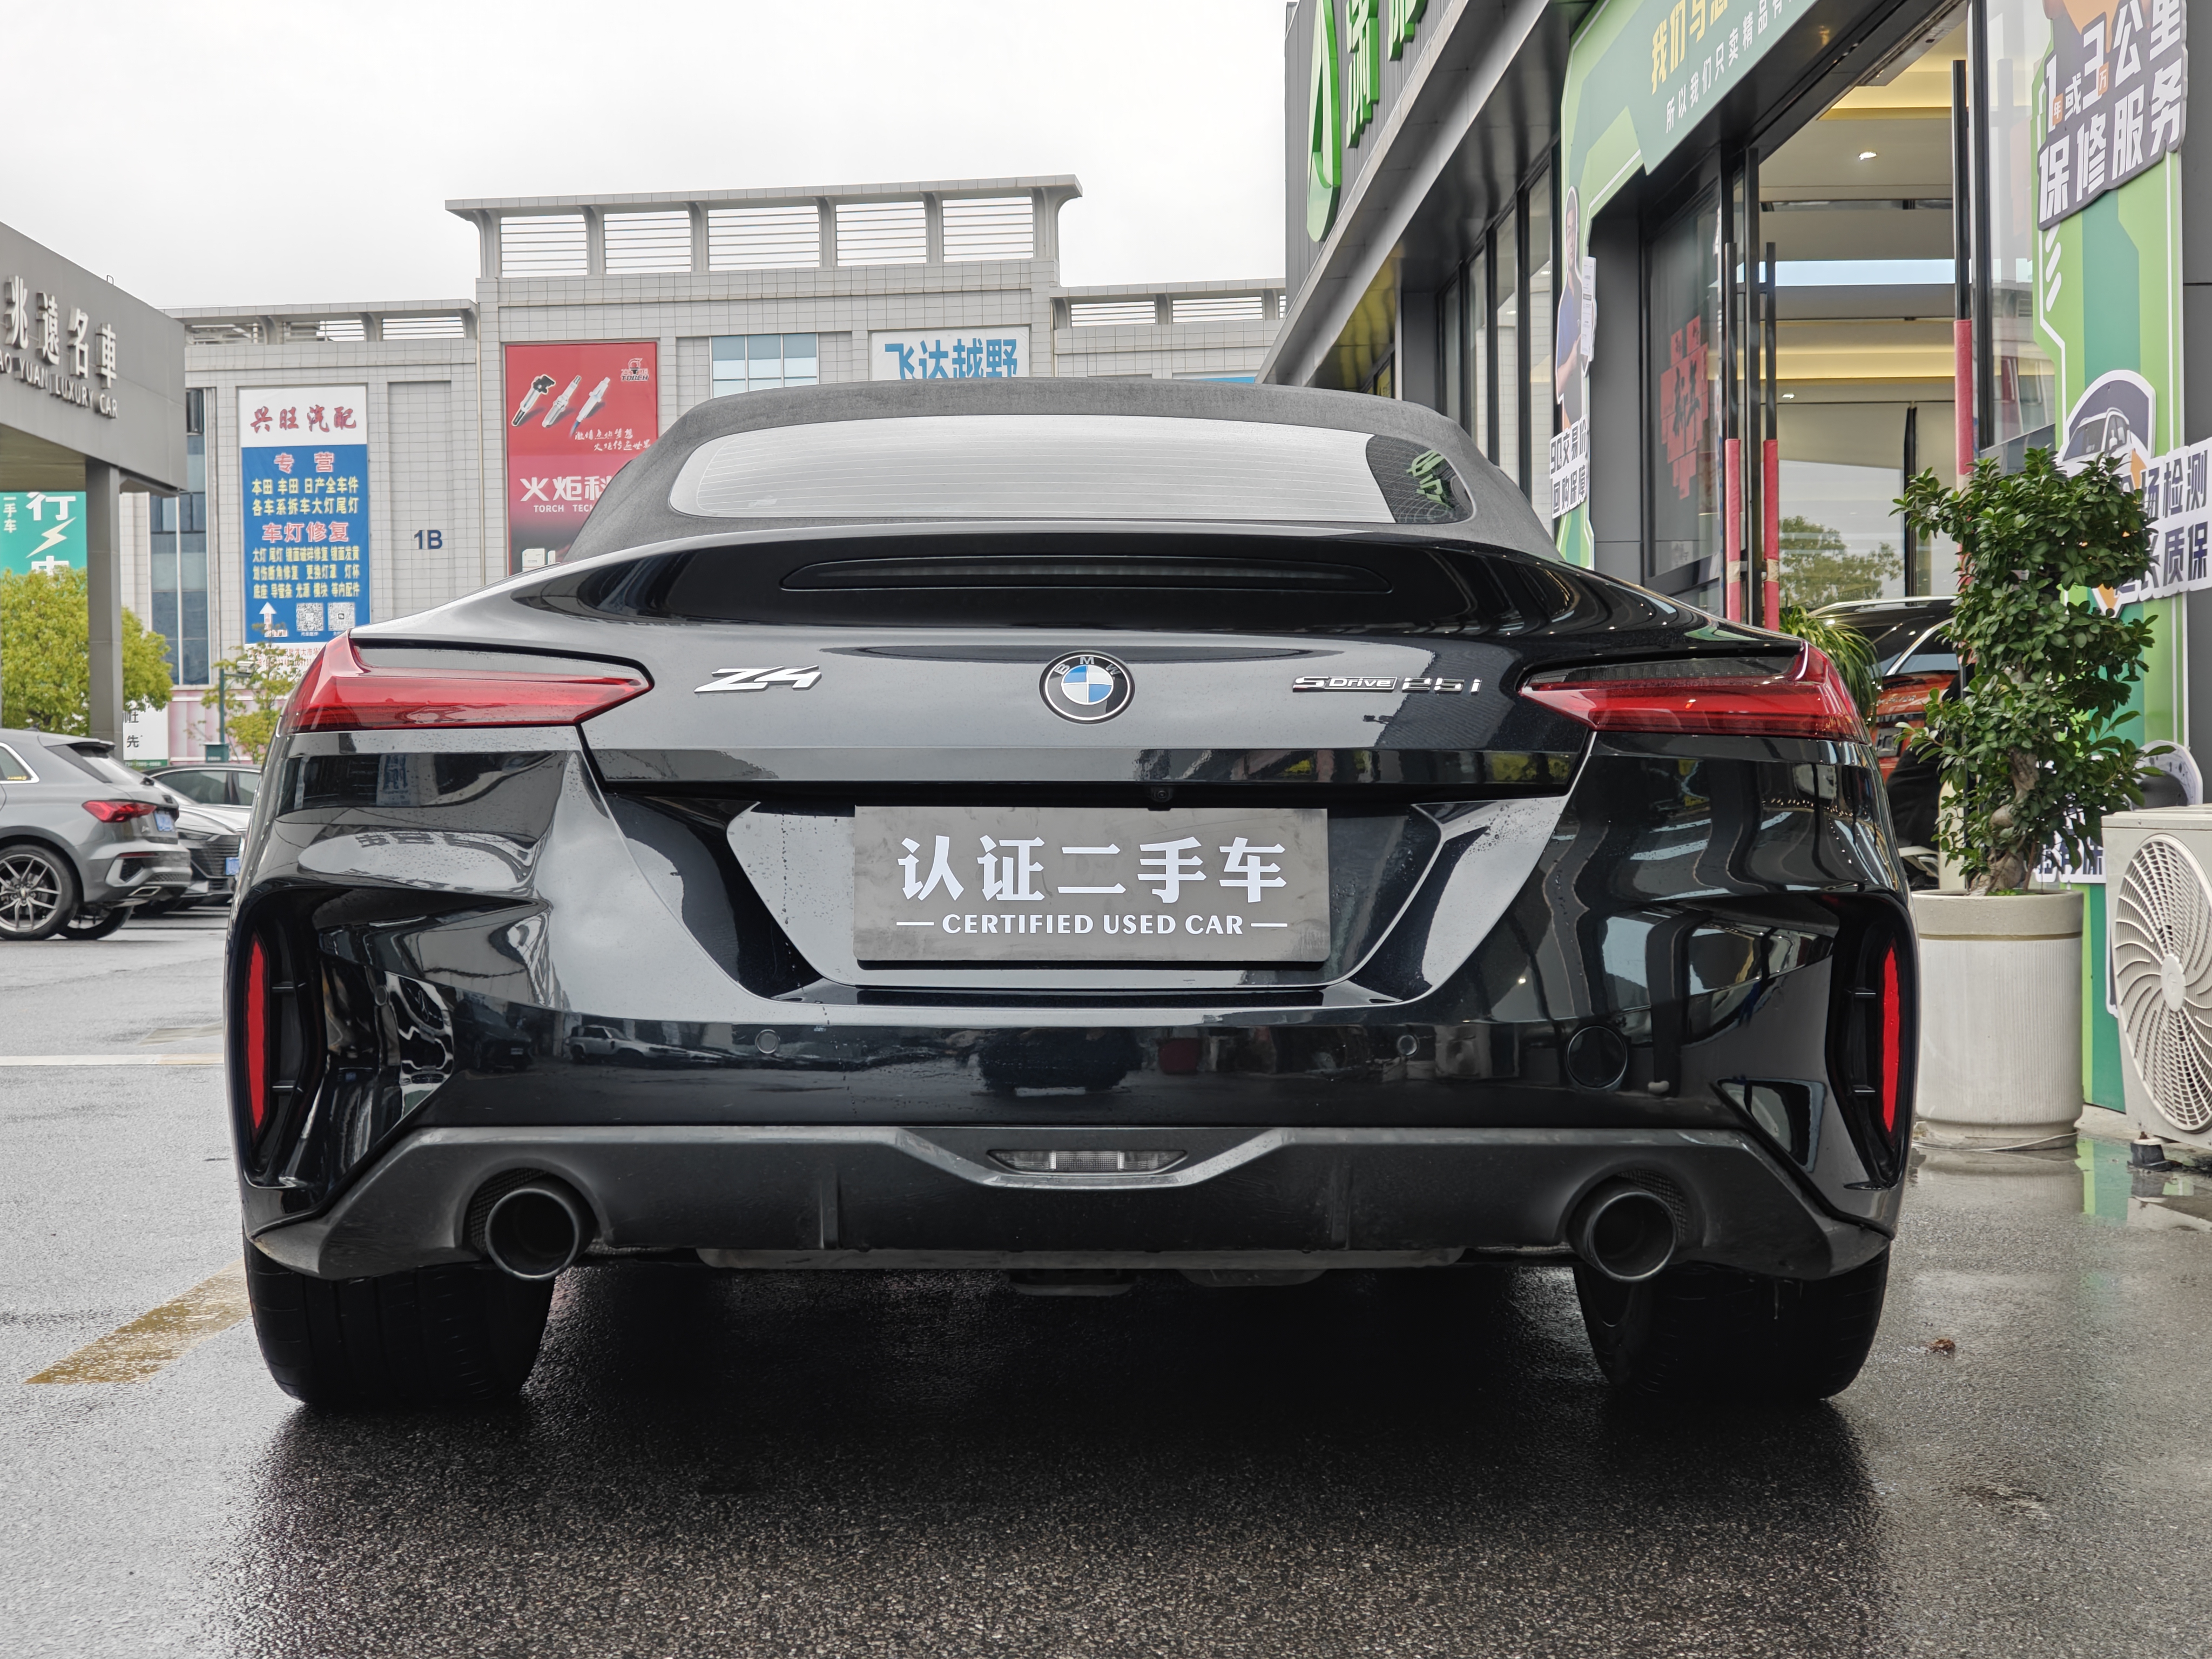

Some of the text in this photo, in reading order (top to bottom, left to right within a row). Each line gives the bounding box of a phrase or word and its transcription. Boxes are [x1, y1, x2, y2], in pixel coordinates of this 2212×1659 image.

[2039, 57, 2182, 224] 保修服务
[11, 275, 117, 389] 兆遠名車
[885, 338, 1017, 380] 飞达越野
[19, 357, 48, 388] YUAN
[56, 374, 94, 409] LUXURY
[99, 393, 118, 419] CAR
[250, 404, 356, 434] 兴旺汽配
[252, 476, 359, 496] 本田 丰田 日产全车件
[534, 504, 564, 512] TORCH
[262, 521, 349, 544] 车灯修复
[414, 530, 443, 550] 1B
[252, 547, 267, 562] 大灯
[694, 664, 822, 693] Z4
[1054, 656, 1121, 676] BMW
[898, 835, 1287, 903] 认证二手车
[942, 913, 1244, 936] CERTIFIED USED CAR
